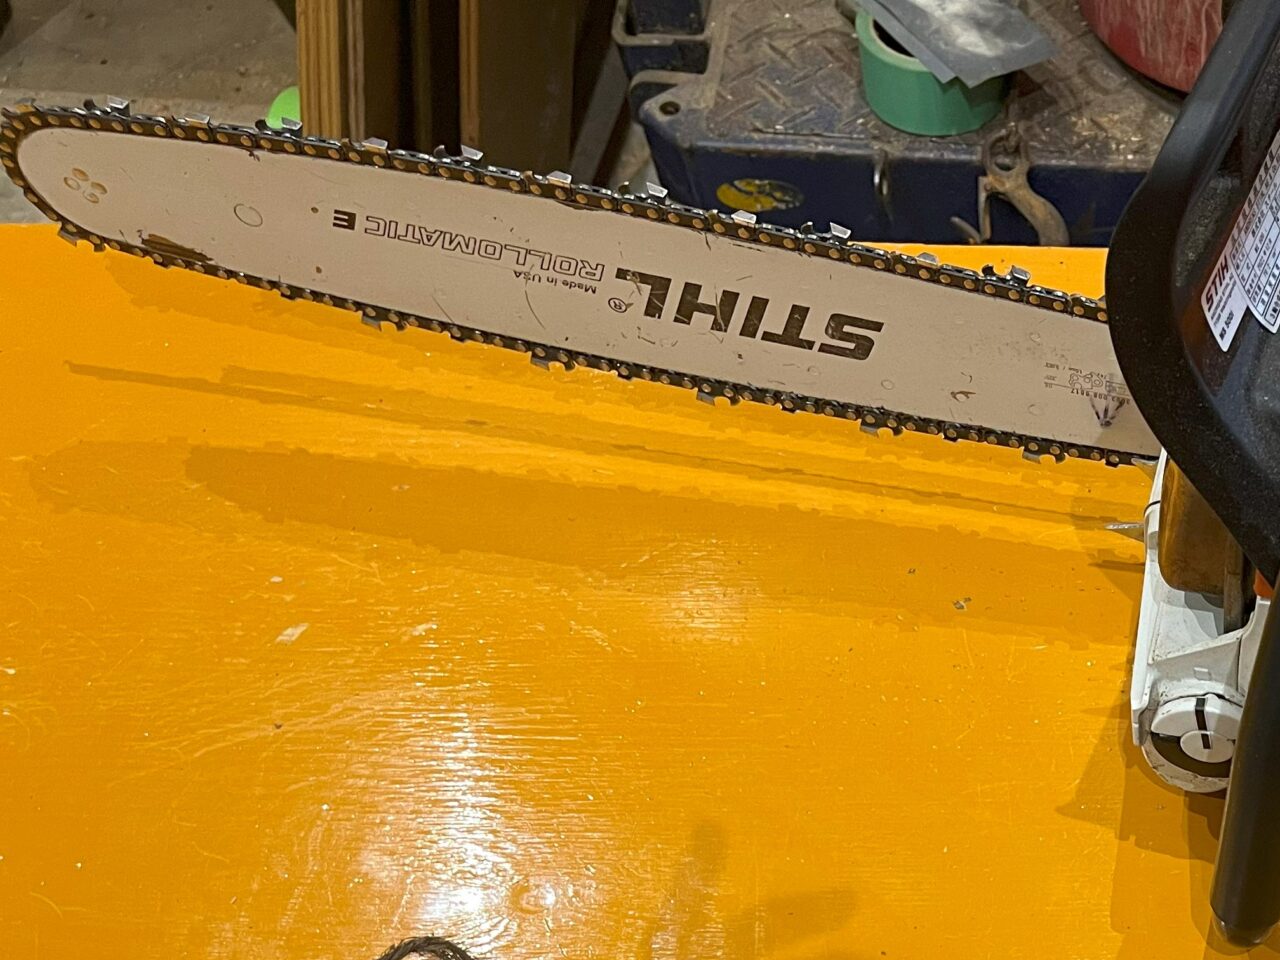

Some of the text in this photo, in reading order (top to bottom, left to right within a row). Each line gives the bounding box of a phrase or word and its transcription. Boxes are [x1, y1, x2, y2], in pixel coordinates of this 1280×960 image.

[333, 209, 605, 281] ROLLOMATIC E
[513, 269, 597, 294] Made in USA
[615, 267, 884, 361] STIHL
[1206, 254, 1229, 313] STIH
